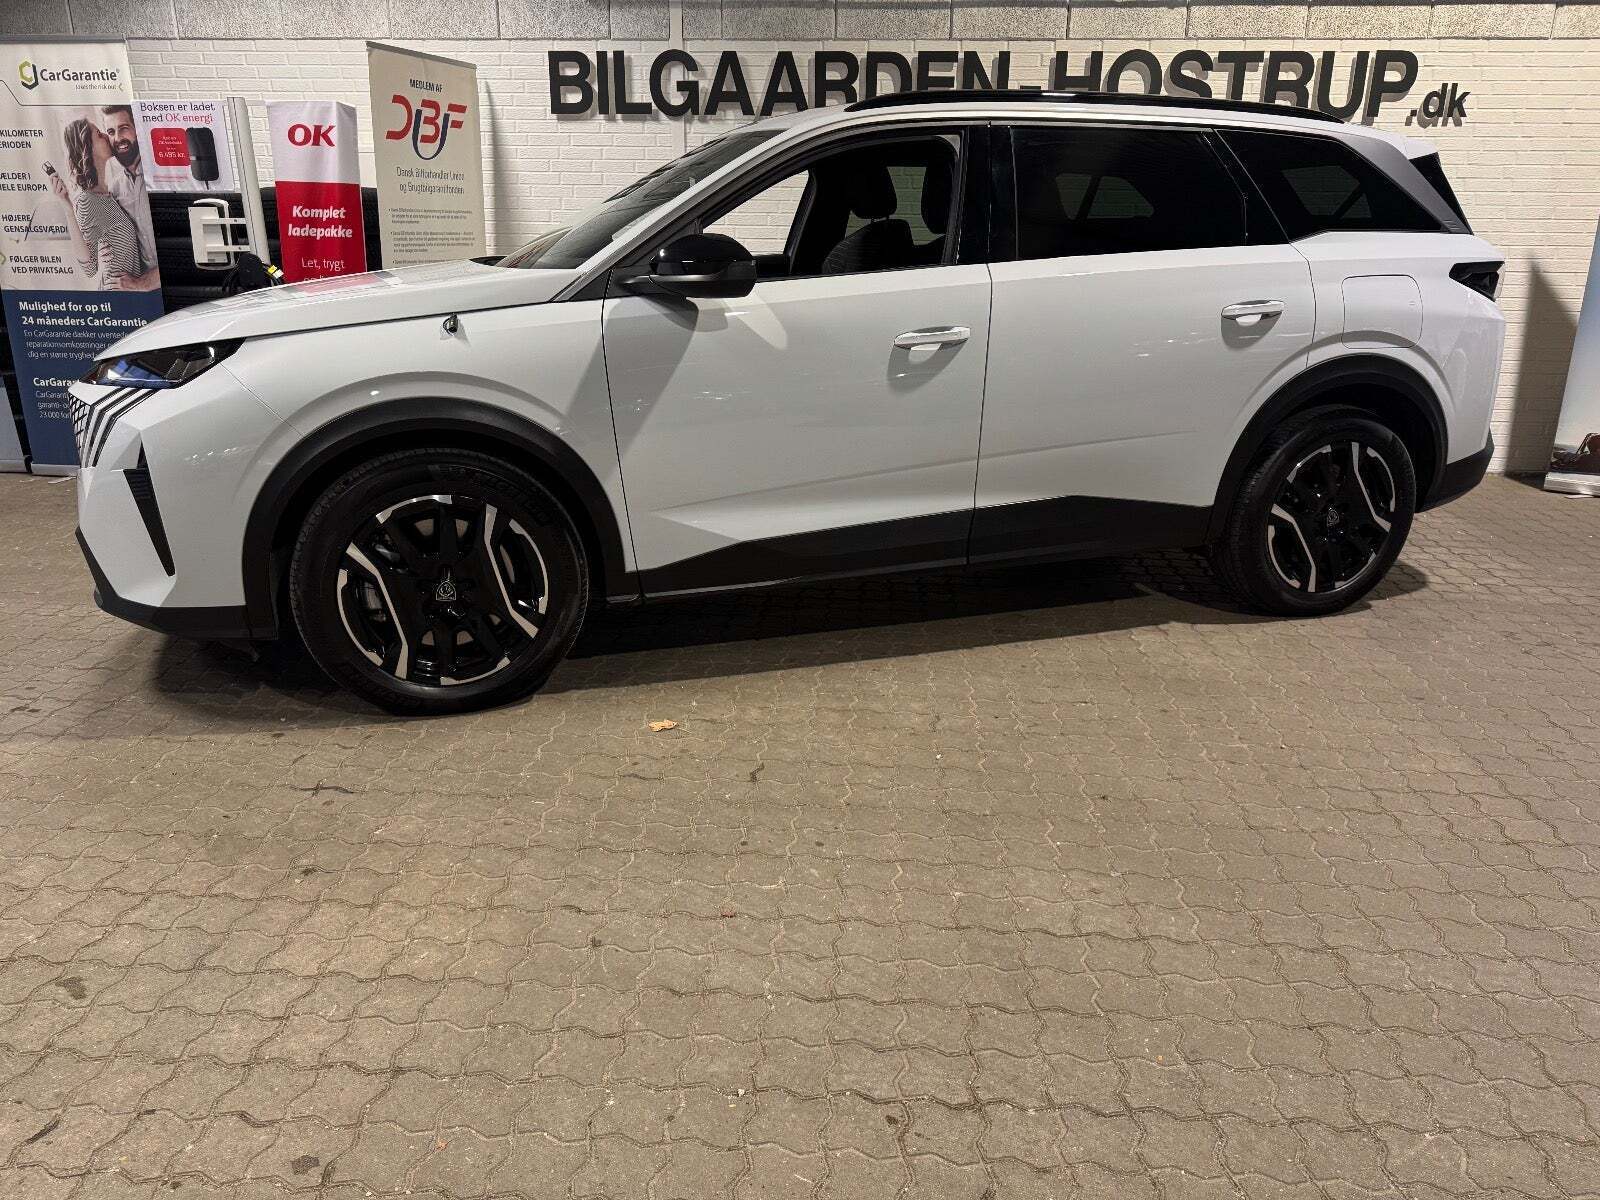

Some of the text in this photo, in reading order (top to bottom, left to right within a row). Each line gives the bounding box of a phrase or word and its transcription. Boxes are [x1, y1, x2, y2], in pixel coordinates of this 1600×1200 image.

[40, 68, 118, 82] CarGarantie
[410, 79, 434, 91] MEDLEM
[140, 102, 174, 111] Boksen
[142, 113, 213, 124] med OK energi
[0, 129, 44, 138] KILOMETER
[287, 123, 336, 147] OK
[17, 184, 48, 192] EUROPA
[2, 214, 32, 222] HØJERE
[292, 205, 347, 221] Komplet
[4, 225, 69, 233] GENSALGSVÆRDI
[288, 223, 353, 240] ladepakke
[9, 255, 62, 263] FØLGER BILEN
[301, 257, 345, 272] Let, trygt
[11, 266, 74, 274] VED PRIVATSALG
[19, 301, 112, 313] Mulighed for op til
[21, 315, 148, 327] 24 måneders CarGarantie
